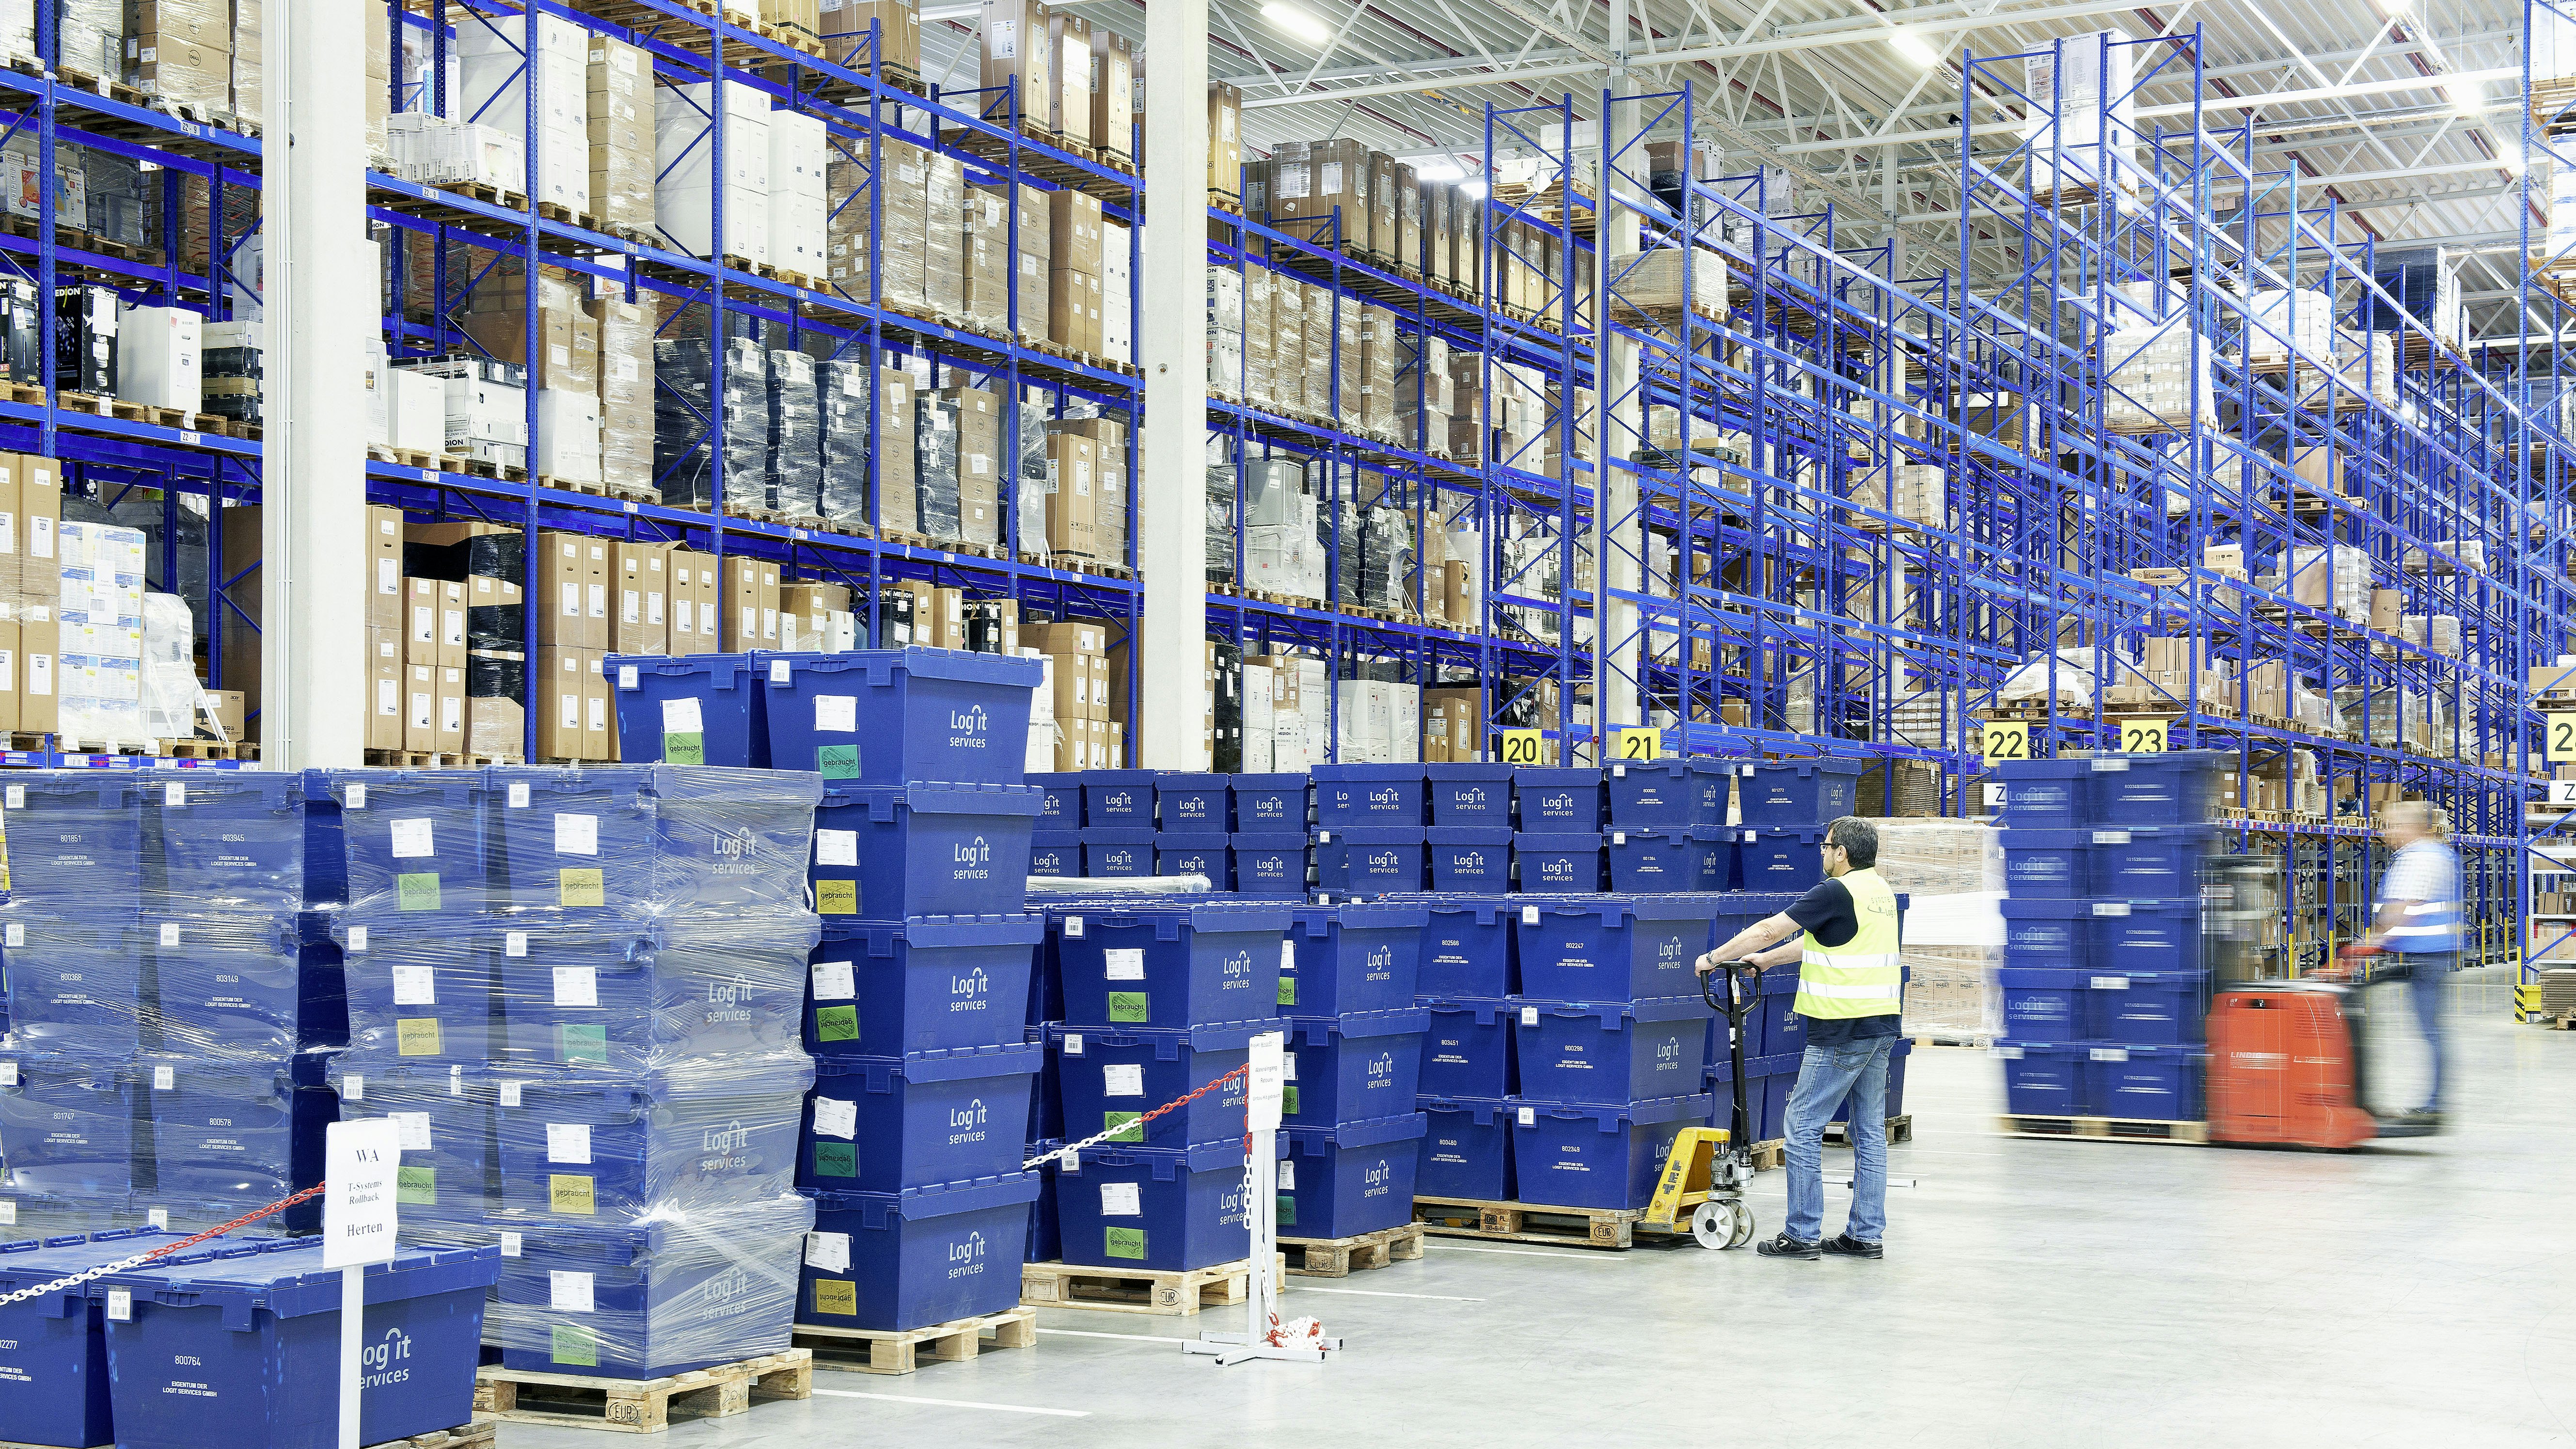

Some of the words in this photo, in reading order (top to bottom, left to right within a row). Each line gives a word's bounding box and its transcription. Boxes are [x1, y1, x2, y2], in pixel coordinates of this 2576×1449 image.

[57, 165, 80, 175] MDION
[55, 287, 81, 297] EDION
[950, 737, 985, 748] services
[2128, 729, 2161, 751] 23
[2555, 723, 2576, 751] 2
[1508, 737, 1536, 762] 20
[1627, 736, 1651, 759] 21
[1990, 731, 2022, 757] 22
[824, 759, 855, 767] gebraucht
[712, 863, 756, 875] services
[954, 870, 988, 879] services
[405, 888, 436, 896] gebraucht
[1223, 980, 1249, 989] services
[951, 1000, 986, 1011] services
[821, 1018, 852, 1028] gebraucht
[403, 1032, 435, 1041] gebraucht
[209, 1118, 231, 1126] 800578
[356, 1149, 379, 1163] WA
[702, 1157, 746, 1171] services
[348, 1181, 382, 1193] T-Systems
[1365, 1186, 1388, 1197] services
[555, 1189, 590, 1197] gebraucht
[349, 1193, 379, 1205] Rollback
[348, 1223, 383, 1237] Herten
[1598, 1227, 1611, 1237] EUR
[175, 1355, 201, 1366] 800764
[363, 1344, 389, 1370] og
[361, 1367, 409, 1389] ervices
[615, 1405, 632, 1419] EUR
